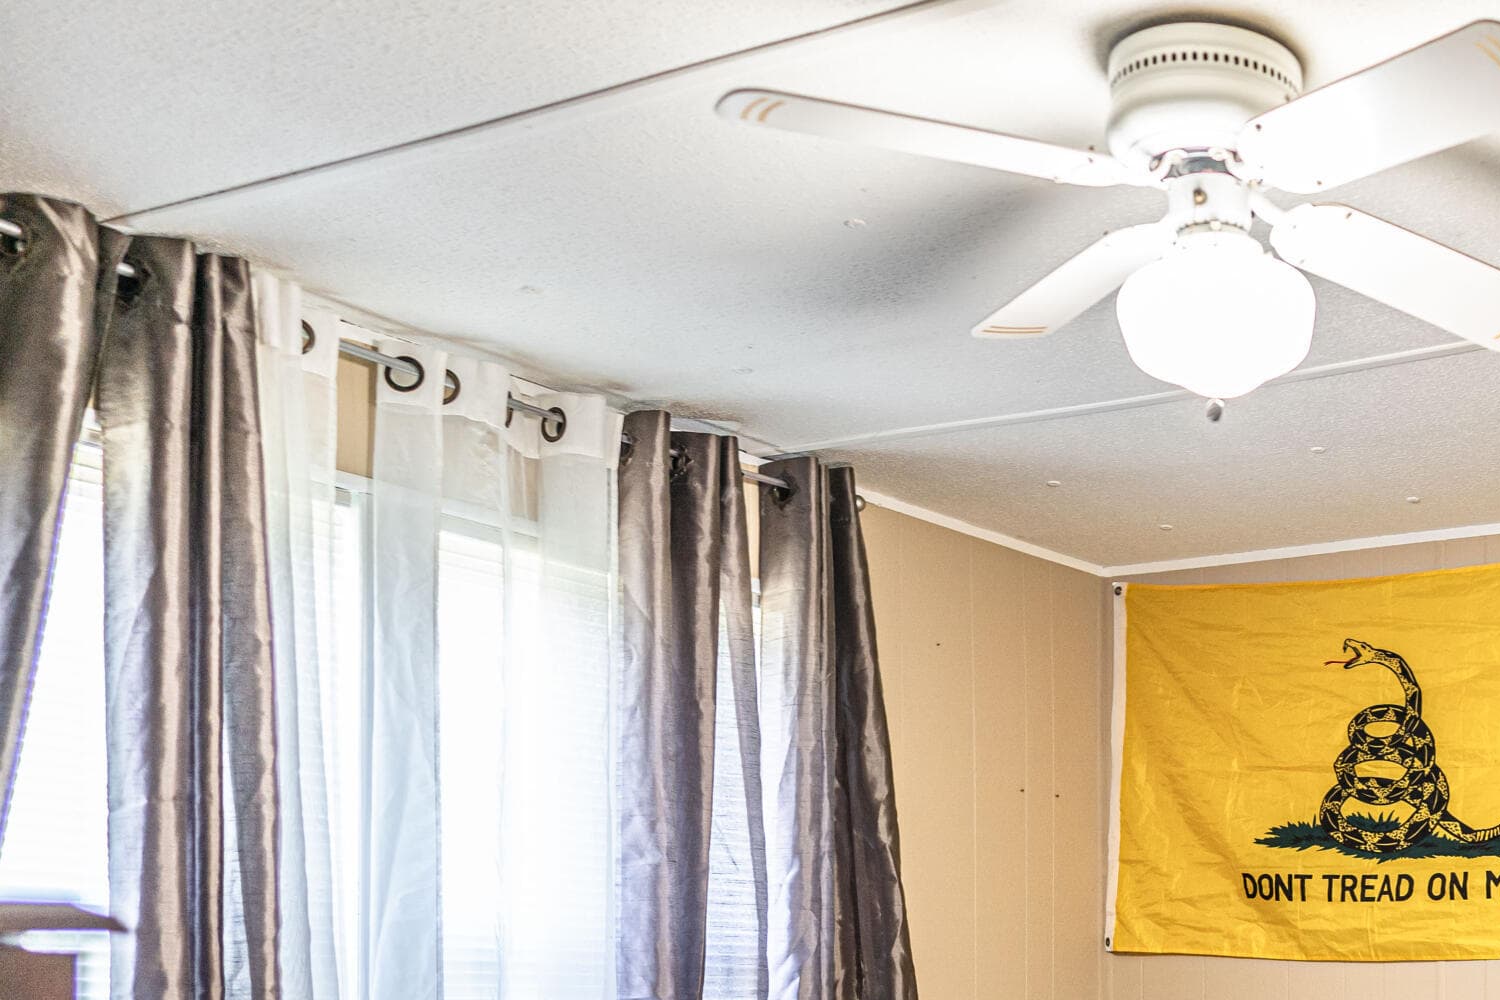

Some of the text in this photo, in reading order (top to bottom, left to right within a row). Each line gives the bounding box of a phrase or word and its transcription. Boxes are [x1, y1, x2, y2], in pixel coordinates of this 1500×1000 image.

[1242, 872, 1313, 903] DONT
[1321, 872, 1415, 904] TREAD
[1426, 870, 1470, 901] ON
